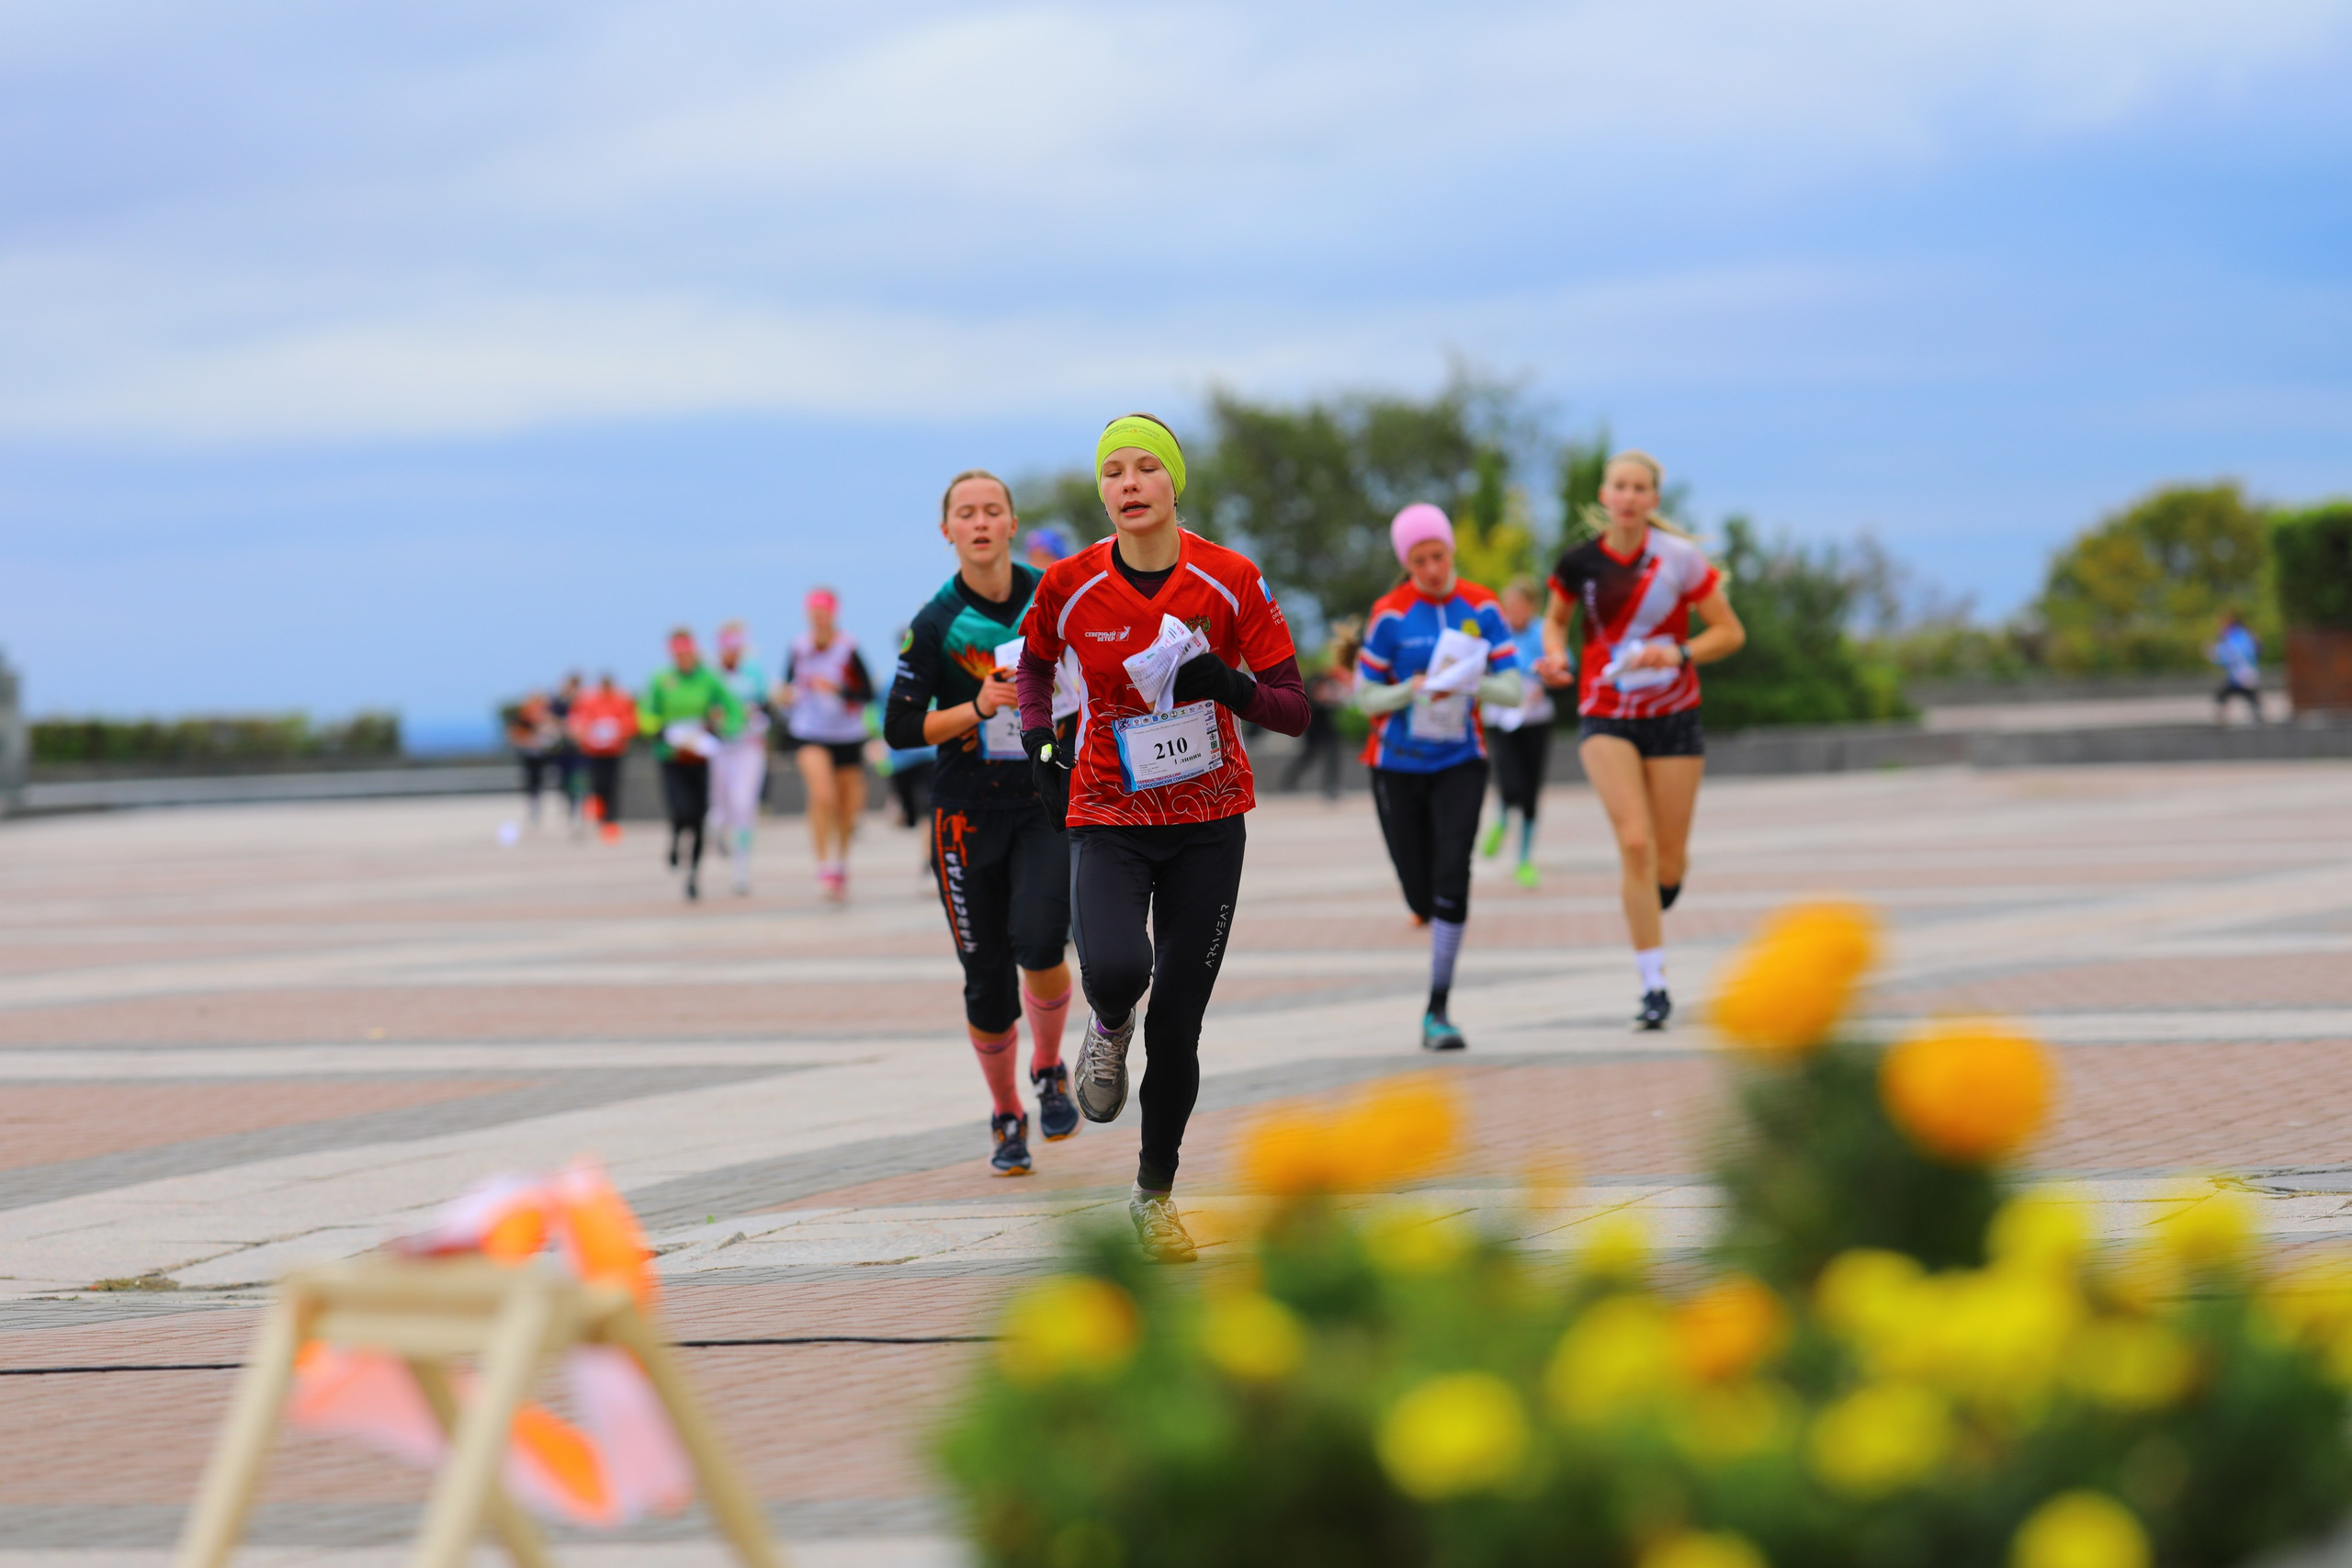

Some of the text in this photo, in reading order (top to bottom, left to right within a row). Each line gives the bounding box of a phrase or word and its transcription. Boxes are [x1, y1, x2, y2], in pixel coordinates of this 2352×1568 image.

[1154, 737, 1188, 761] 210
[1180, 752, 1202, 764] линия
[1136, 772, 1182, 785] ПЕРВЕНСТВО РОССИИ
[1137, 777, 1173, 790] ВСЕРОССИЙСКИЕ
[1173, 768, 1204, 782] СОРЕВНОВАНИЯ
